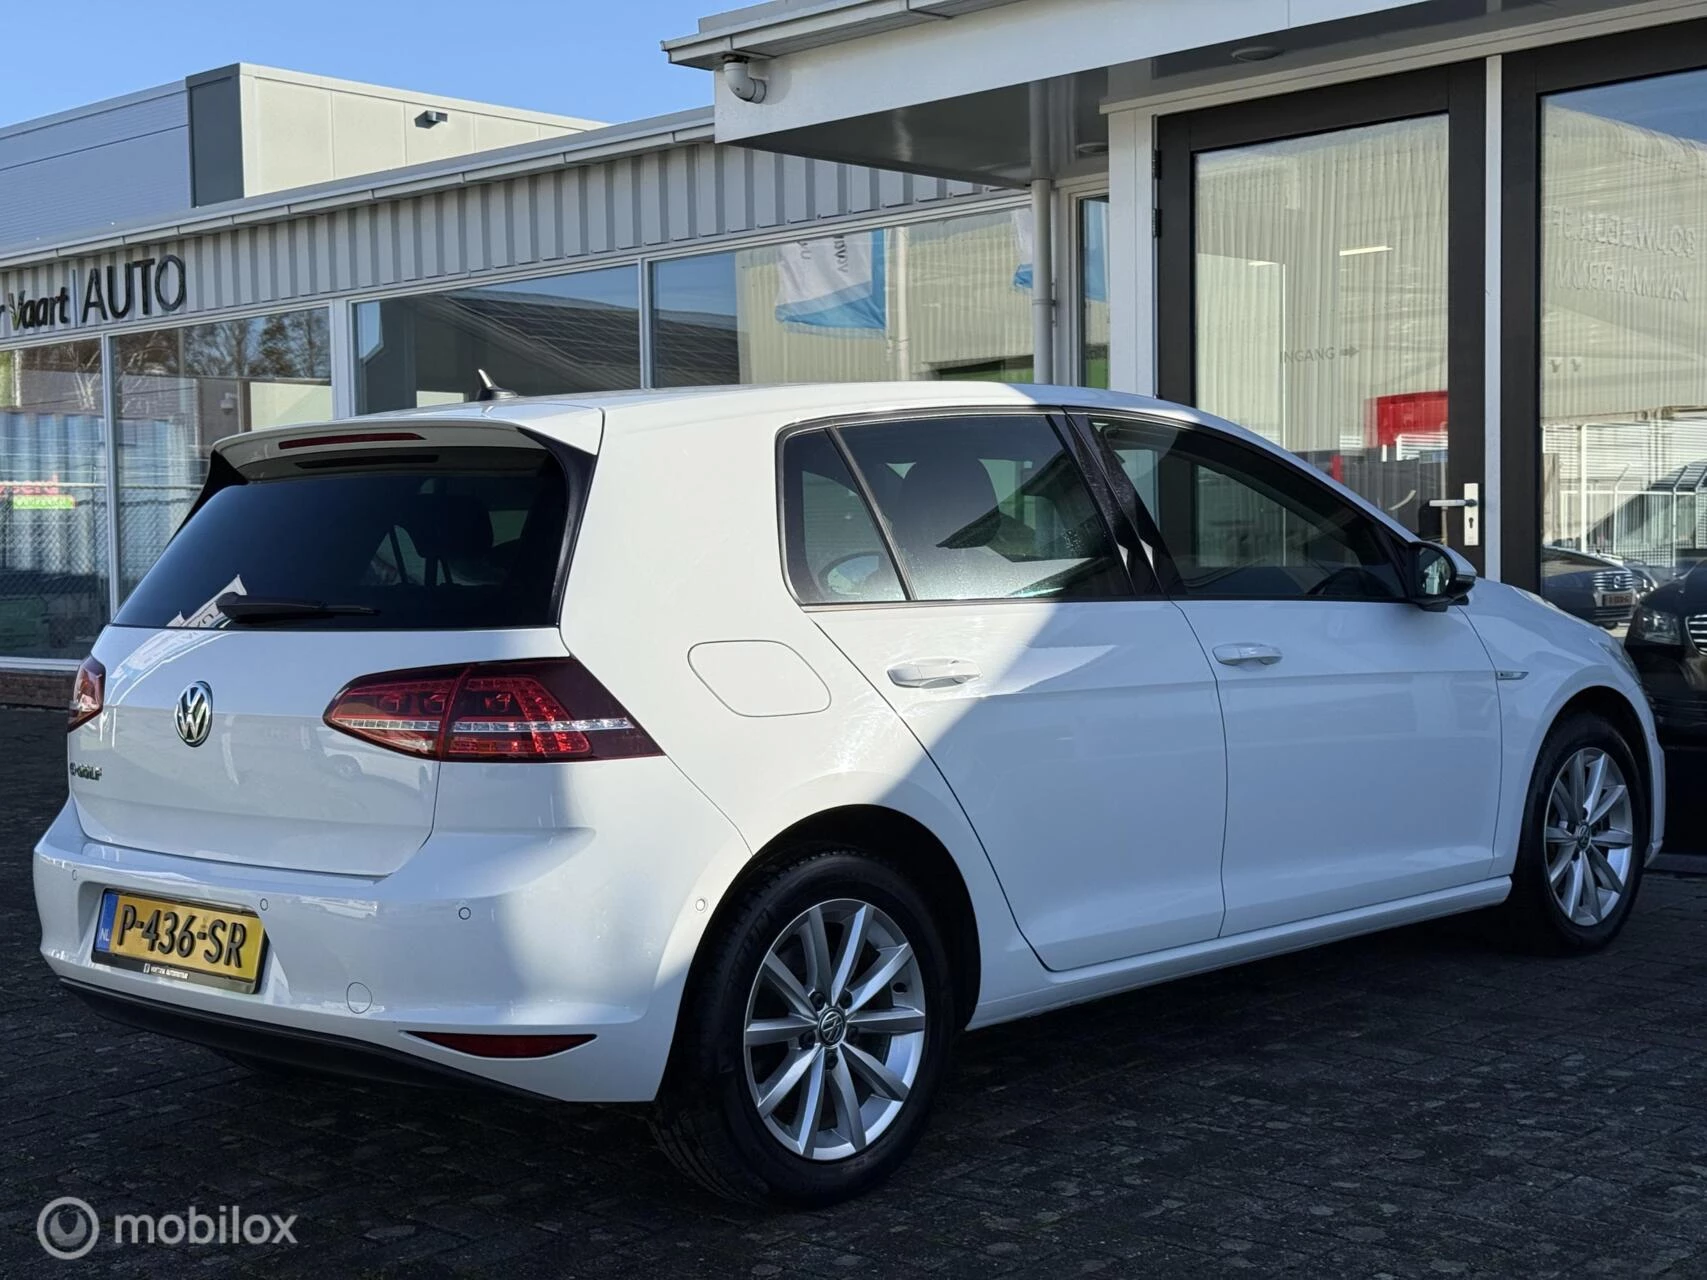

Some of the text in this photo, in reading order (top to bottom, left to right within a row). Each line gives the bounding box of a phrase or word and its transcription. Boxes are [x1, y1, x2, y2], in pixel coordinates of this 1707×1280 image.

[8, 254, 187, 330] Vaart AUTO
[1279, 346, 1336, 364] INGANG
[100, 904, 248, 969] NL P-436-SR
